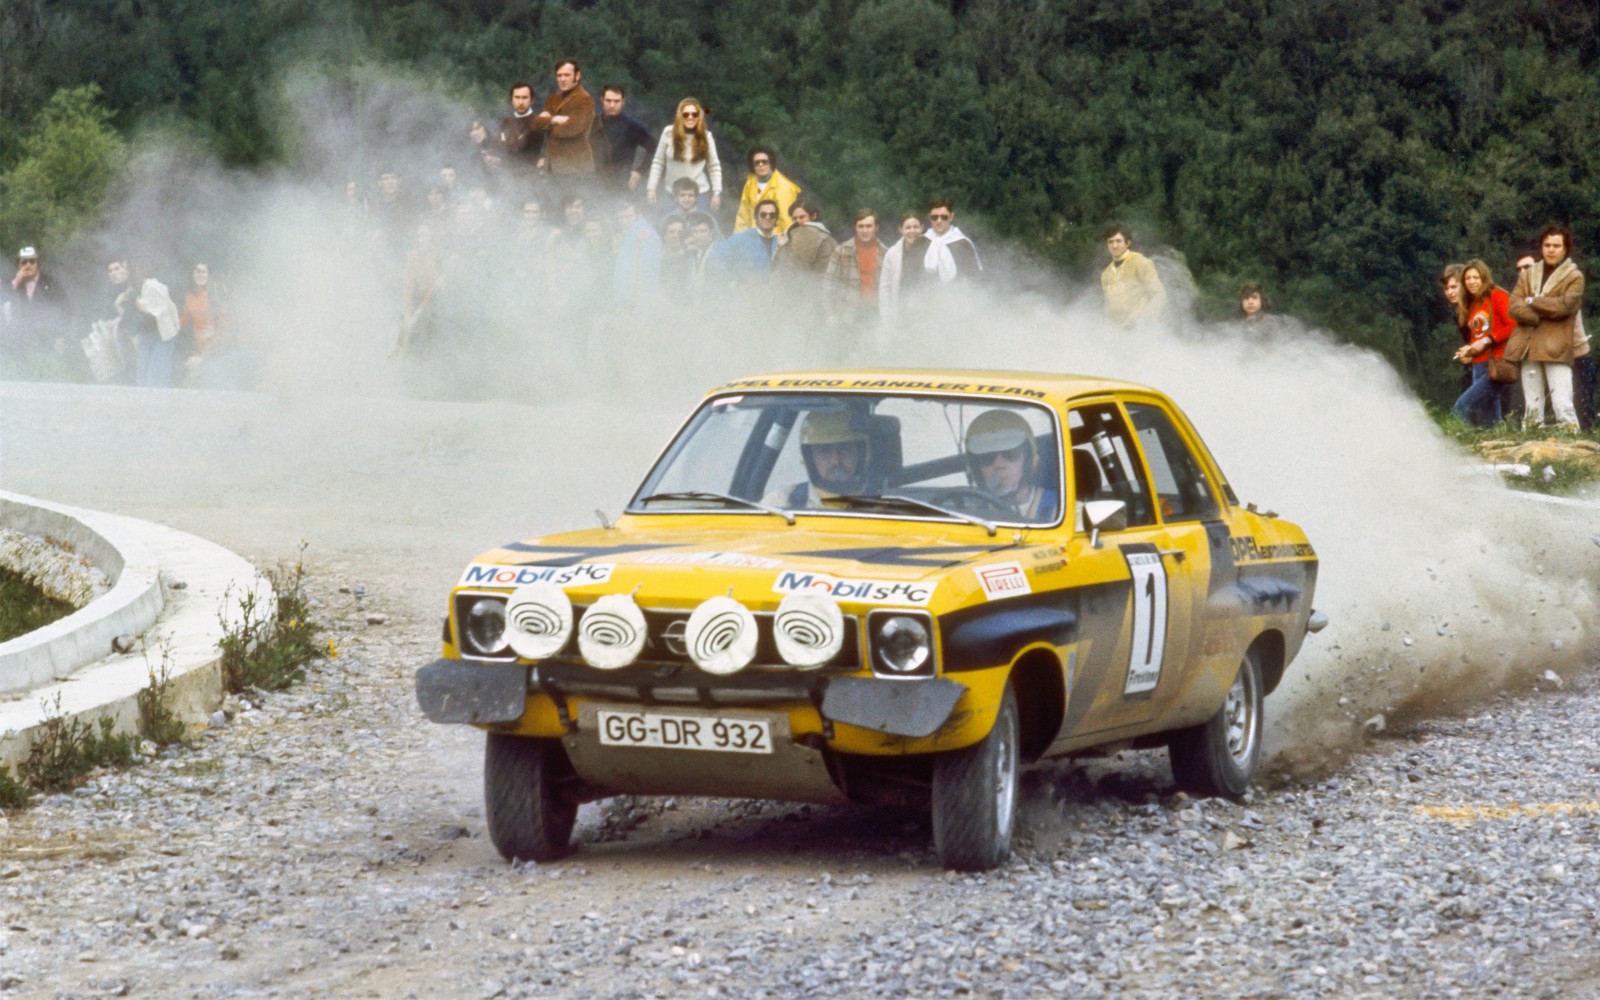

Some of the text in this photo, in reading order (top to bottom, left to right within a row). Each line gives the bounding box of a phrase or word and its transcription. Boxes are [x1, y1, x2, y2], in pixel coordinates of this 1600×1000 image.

[778, 379, 843, 387] EURO
[976, 384, 1046, 399] TEAM
[1230, 536, 1261, 562] OPEL
[465, 566, 557, 585] Mobil
[980, 567, 1025, 593] PIRELLI
[1145, 572, 1156, 665] 1
[605, 715, 767, 749] GG-DR 932
